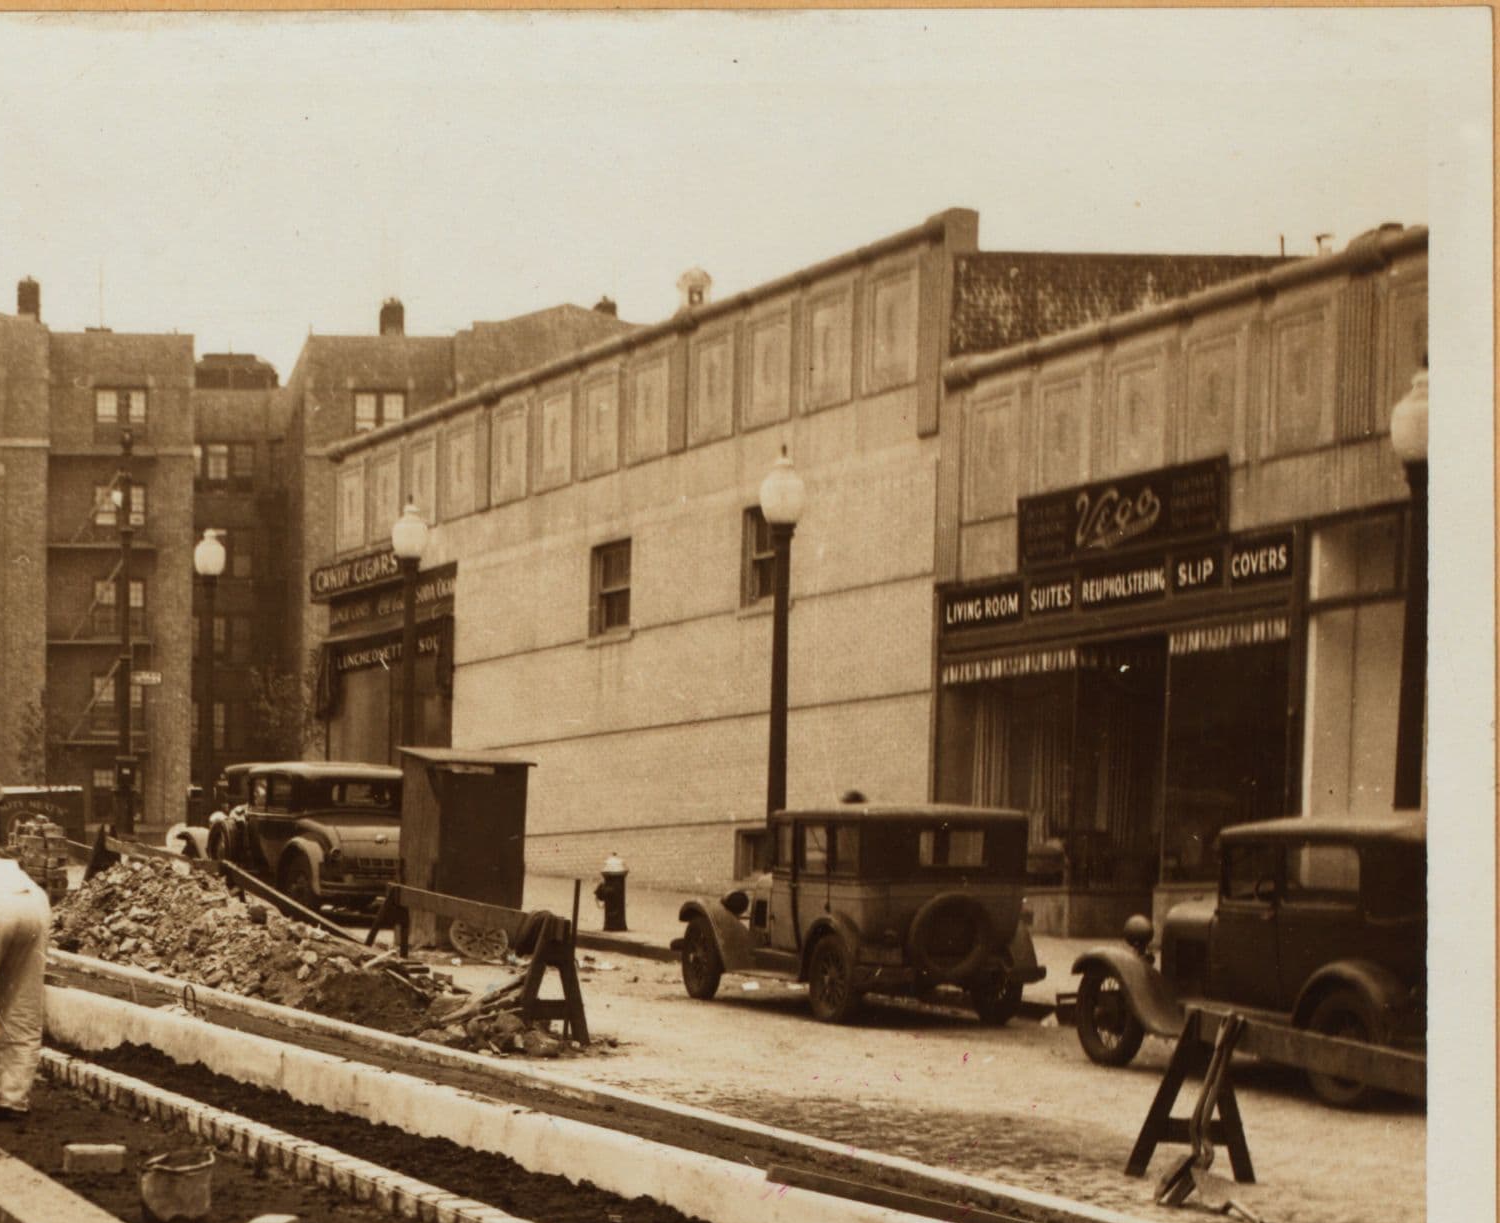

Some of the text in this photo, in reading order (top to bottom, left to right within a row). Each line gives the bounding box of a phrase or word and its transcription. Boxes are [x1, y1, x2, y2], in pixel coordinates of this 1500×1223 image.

[316, 553, 398, 592] CANDY CIGARS
[946, 545, 1288, 625] LIVING ROOM SUITES REUPHOLSTERING SLIP COVERS
[337, 642, 403, 670] LUNCHEONETT
